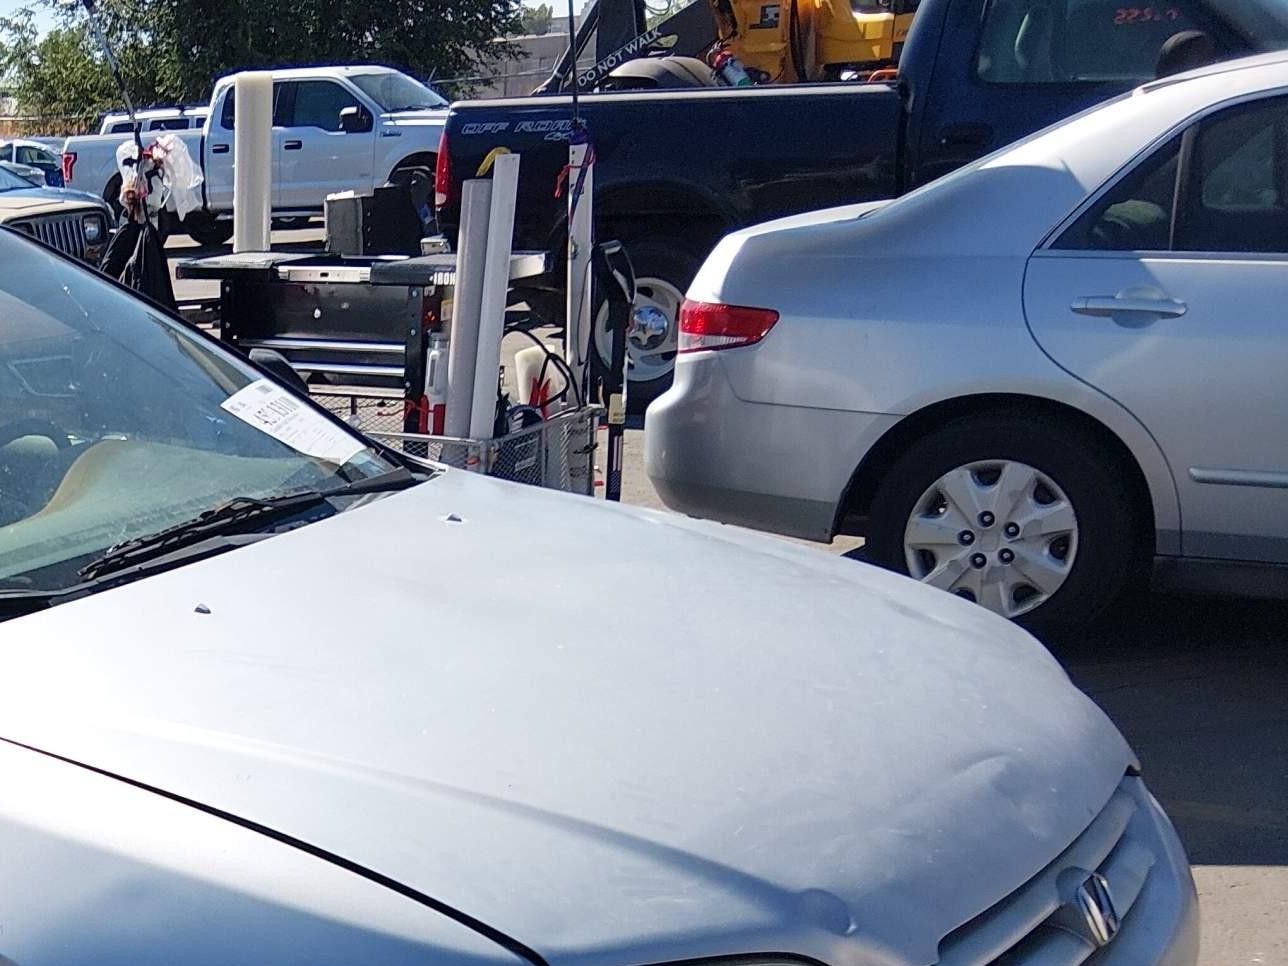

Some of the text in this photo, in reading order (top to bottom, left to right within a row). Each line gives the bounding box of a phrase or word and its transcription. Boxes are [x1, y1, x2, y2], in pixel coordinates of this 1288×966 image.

[577, 28, 662, 86] DO NOT WALK
[461, 122, 509, 135] OFF
